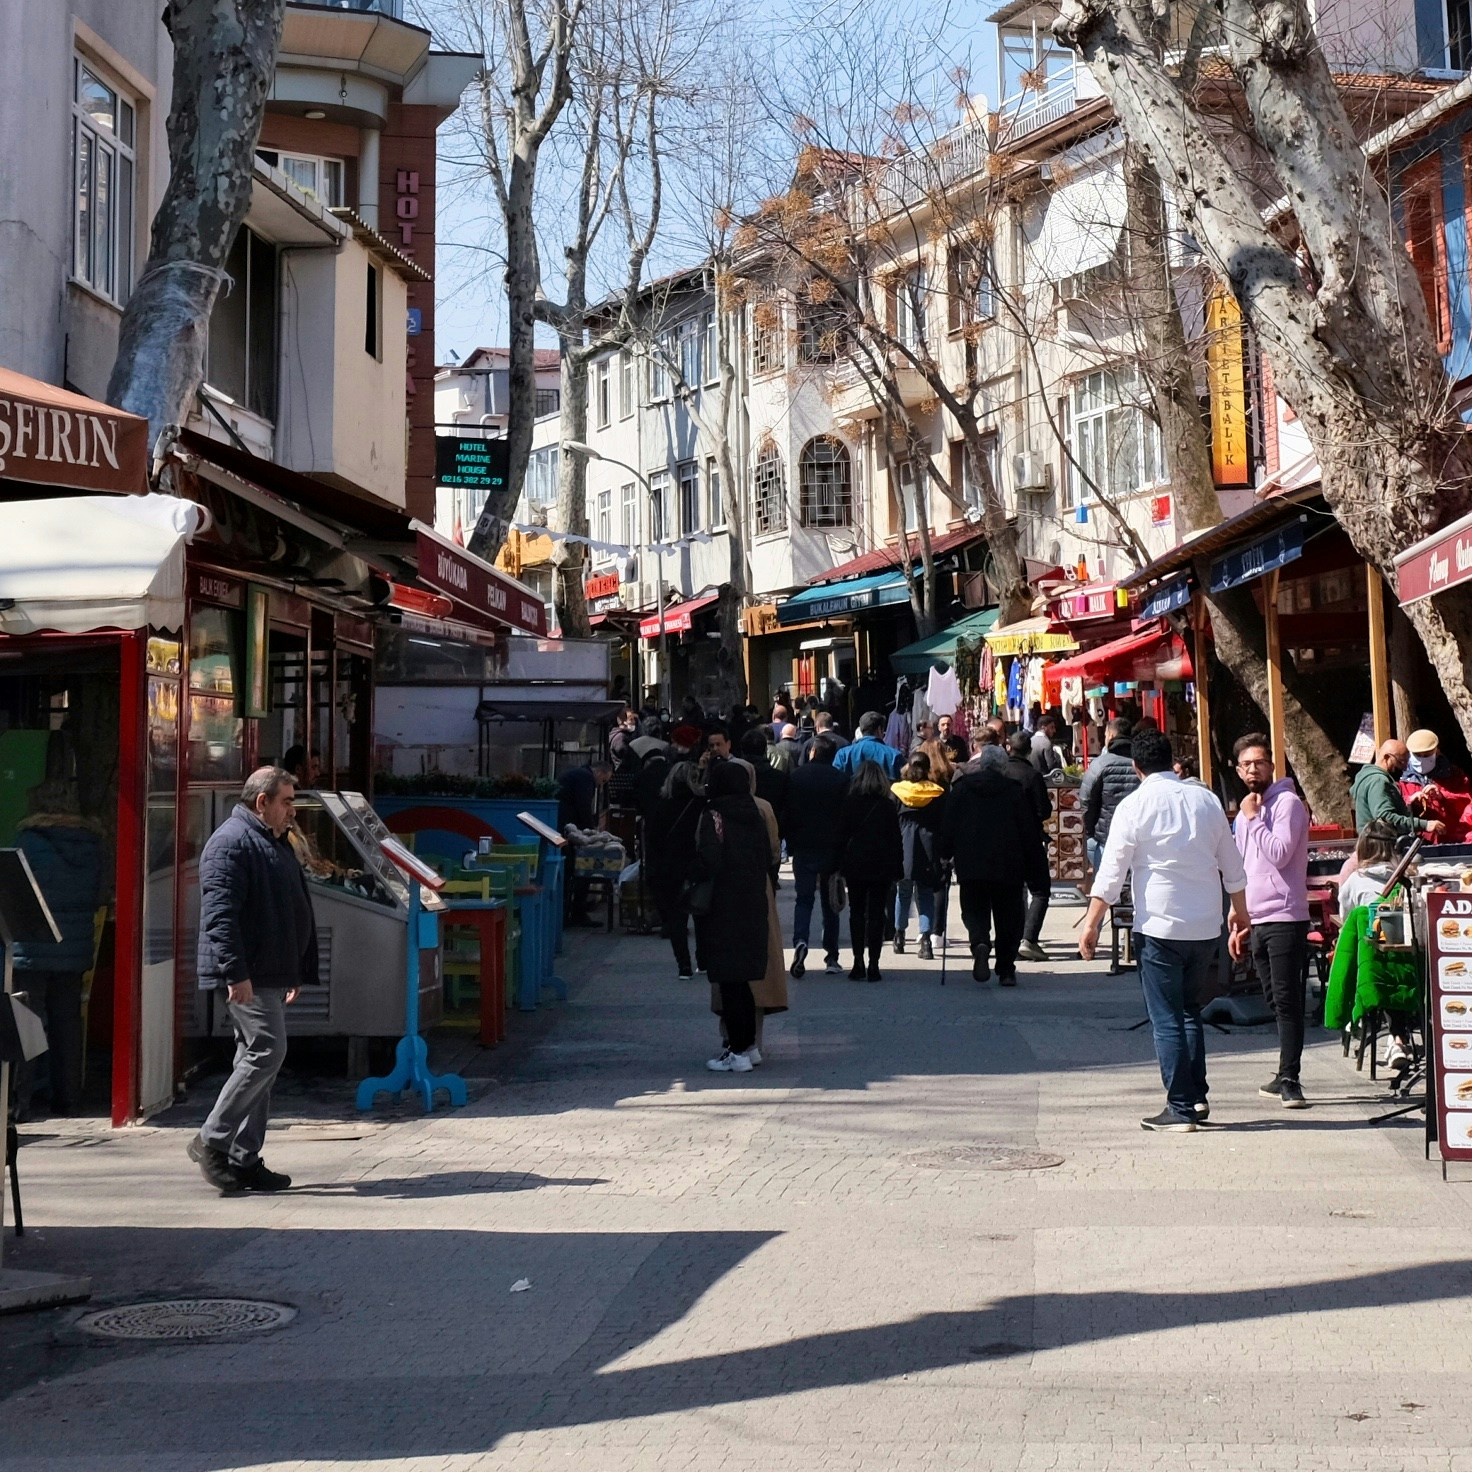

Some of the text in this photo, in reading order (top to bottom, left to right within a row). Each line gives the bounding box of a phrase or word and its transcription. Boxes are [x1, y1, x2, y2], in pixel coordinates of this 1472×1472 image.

[459, 442, 488, 452] HOTEL
[457, 465, 487, 475] HOUSE
[441, 475, 462, 483] 0216
[437, 550, 468, 592] BÜYÜKADA
